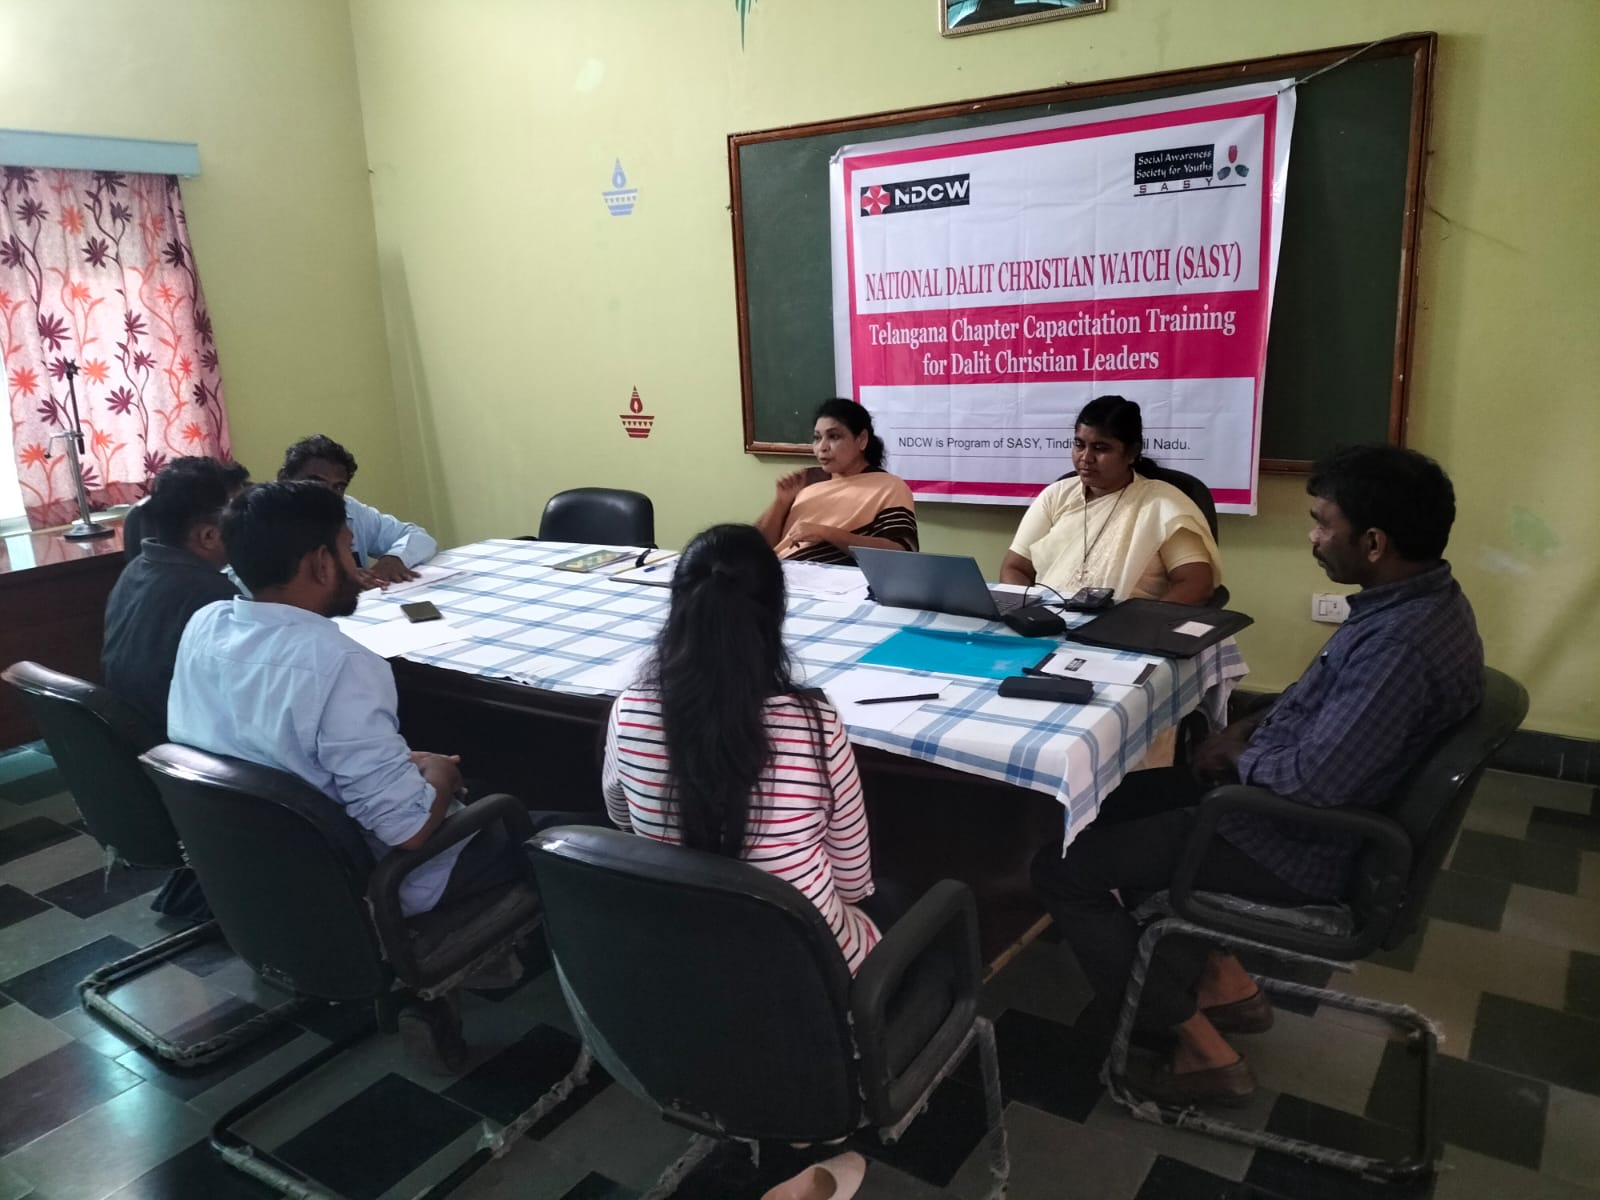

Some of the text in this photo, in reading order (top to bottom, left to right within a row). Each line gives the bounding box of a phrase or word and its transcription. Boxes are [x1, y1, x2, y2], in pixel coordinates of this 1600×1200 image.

[1136, 161, 1212, 179] Society for Youths
[1138, 150, 1212, 166] Social Awareness
[895, 180, 969, 205] NDCW
[865, 241, 1242, 302] NATIONAL DALIT CHRISTIAN WATCH (SASY)
[869, 303, 1237, 350] Telangana Chapter Capacitation Training
[922, 344, 1160, 376] for Dalit Christian Leaders
[898, 437, 933, 448] NDCW
[935, 437, 944, 448] is
[947, 437, 991, 450] Program
[993, 437, 1004, 448] of
[1006, 438, 1042, 450] SASY,
[1045, 438, 1074, 449] Tindi
[1153, 438, 1191, 450] Nadu.
